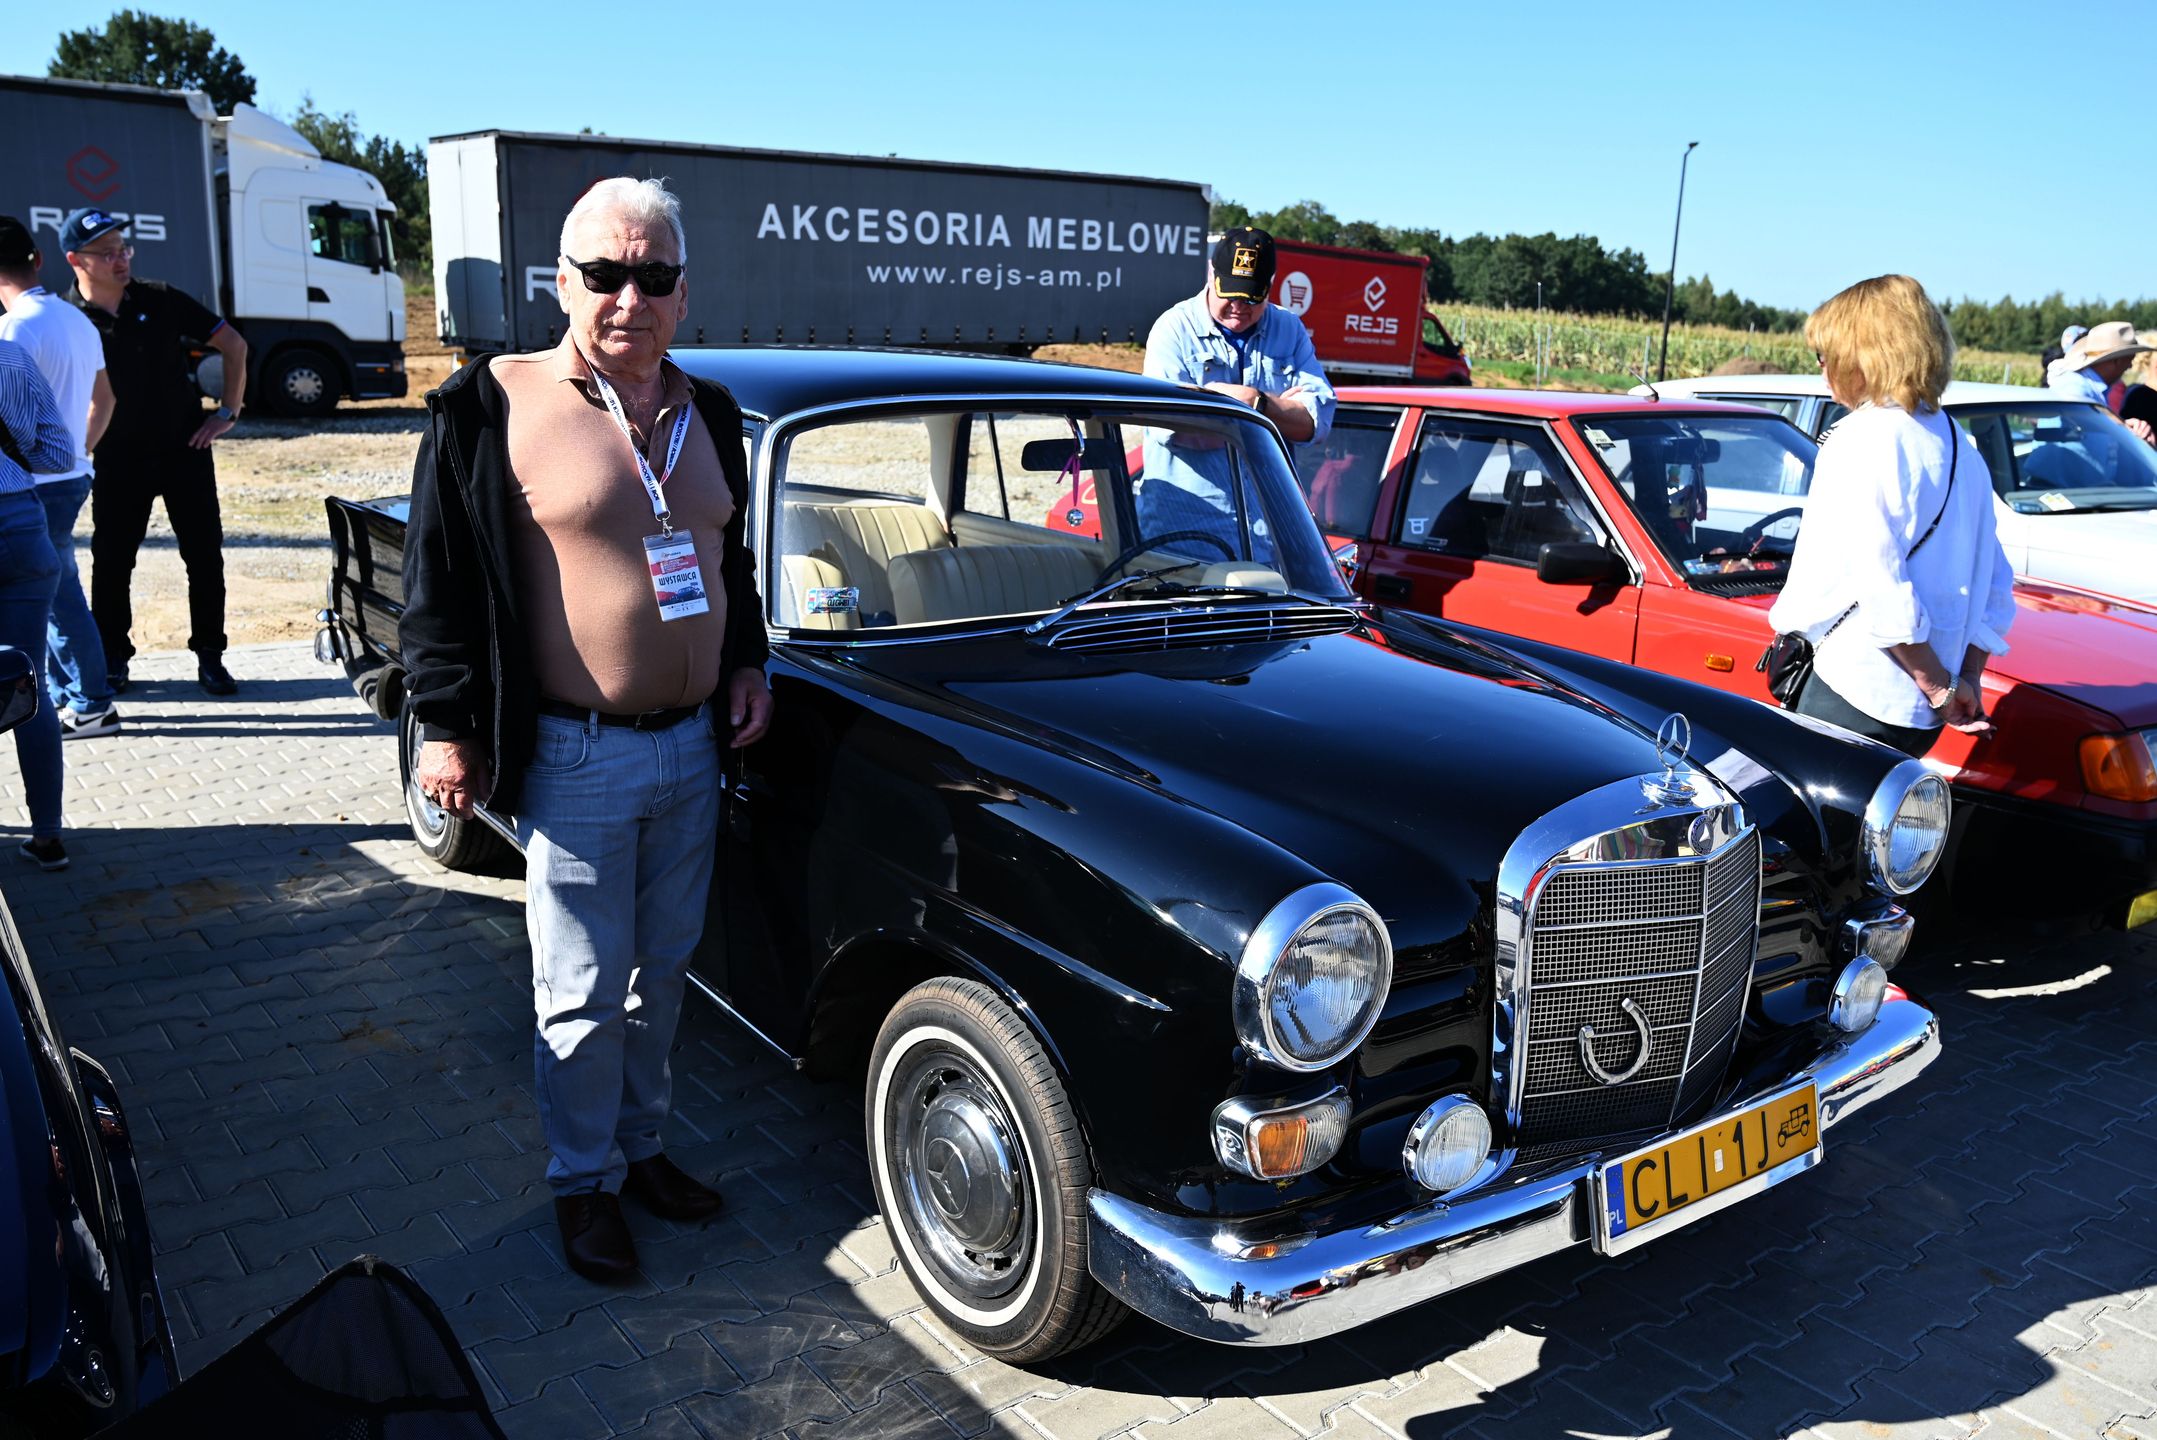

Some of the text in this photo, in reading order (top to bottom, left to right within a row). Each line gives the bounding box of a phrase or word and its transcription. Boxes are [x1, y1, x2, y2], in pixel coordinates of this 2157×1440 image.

[29, 205, 167, 241] RJS
[756, 203, 1201, 256] AKCESORIA MEBLOWE
[866, 263, 1122, 292] www.rejs-am.pl
[1344, 314, 1399, 335] REJS
[658, 571, 697, 586] WYSTAWCA
[1631, 1110, 1770, 1219] CLI 1J
[1608, 1208, 1624, 1228] PL
